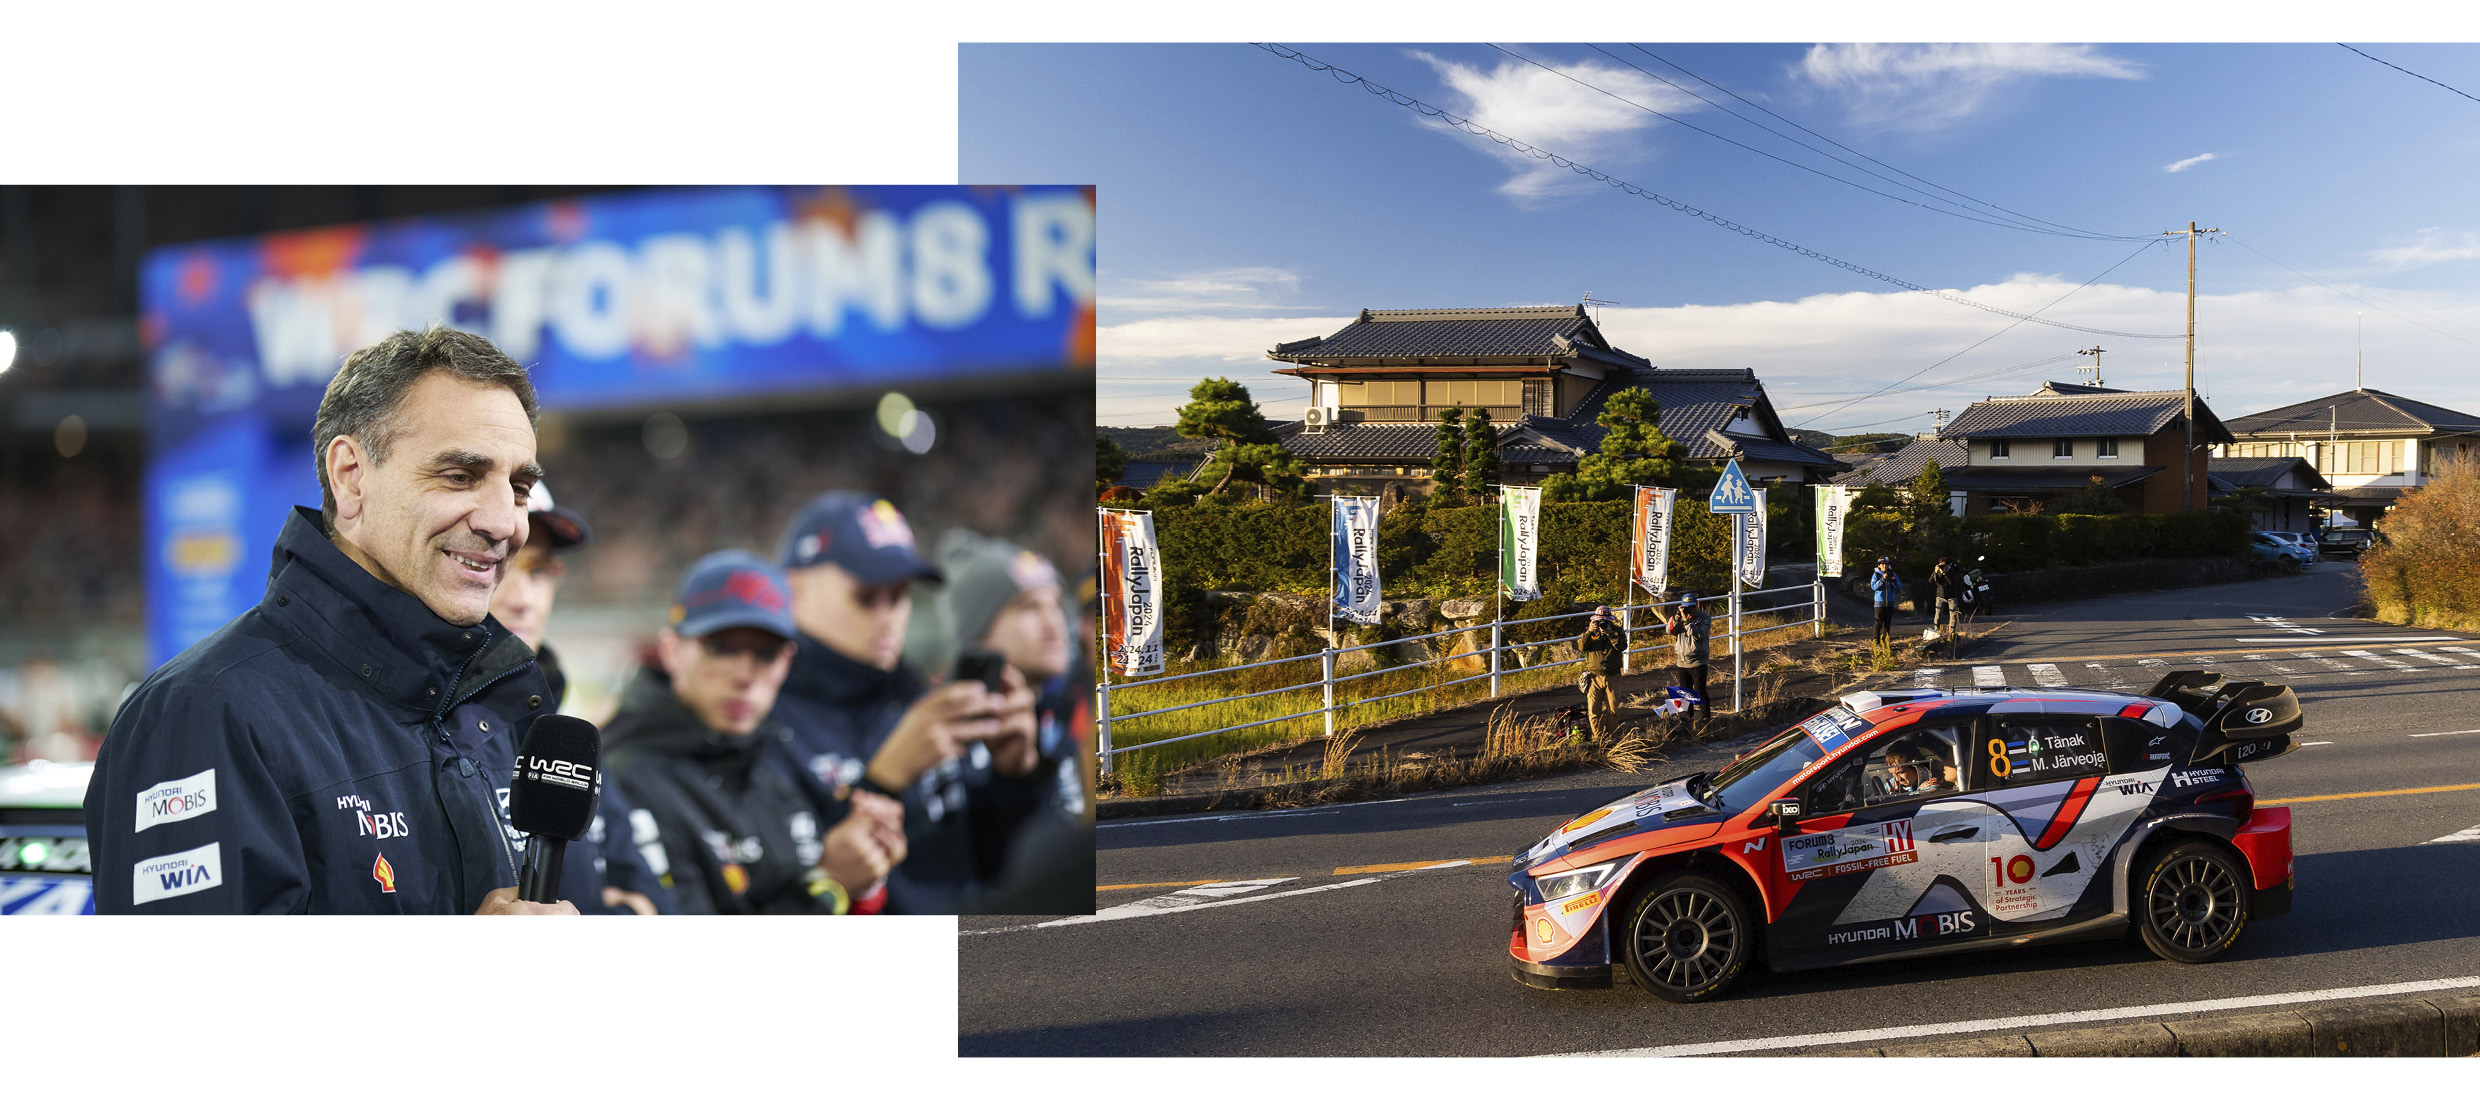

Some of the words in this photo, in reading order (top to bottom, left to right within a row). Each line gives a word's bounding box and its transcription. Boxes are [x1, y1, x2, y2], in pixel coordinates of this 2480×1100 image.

[1825, 506, 1836, 554] RallyJapan
[1517, 515, 1530, 582] RallyJapan
[1647, 512, 1662, 572] RallyJapan
[1352, 528, 1369, 603] RallyJapan
[1126, 546, 1150, 636] RallyJapan
[1364, 574, 1372, 595] 2024
[1143, 602, 1152, 626] 2024
[1118, 644, 1158, 654] 2024.11
[2044, 734, 2084, 750] Tänak
[529, 756, 592, 780] WRC
[1792, 730, 1878, 785] motorsport.hyundai.com
[1988, 738, 2011, 777] 8
[2032, 758, 2049, 771] M.
[2052, 750, 2106, 769] Järveoja
[1827, 763, 1852, 784] HYUNDAI
[2106, 778, 2136, 786] HYUNDAI
[2189, 768, 2224, 777] HYUNDAI
[2192, 776, 2220, 784] STEEL
[144, 787, 182, 804] HYUNDAI
[2119, 781, 2154, 796] WIA
[152, 790, 206, 818] MOBIS
[1882, 820, 1911, 854] HY
[1818, 843, 1874, 859] RallyJapan
[142, 860, 188, 875] HYUNDAI
[160, 864, 210, 890] WIA
[1792, 868, 1822, 880] WRC
[1835, 858, 1890, 874] FOSSIL-FREE
[1890, 854, 1912, 864] FUEL
[1564, 894, 1598, 912] PIRELLI
[1996, 896, 2004, 904] of
[2004, 894, 2036, 903] Strategic
[1996, 902, 2038, 912] Partnership
[1828, 927, 1890, 945] HYUNDAI
[1894, 911, 1976, 941] MOBIS
